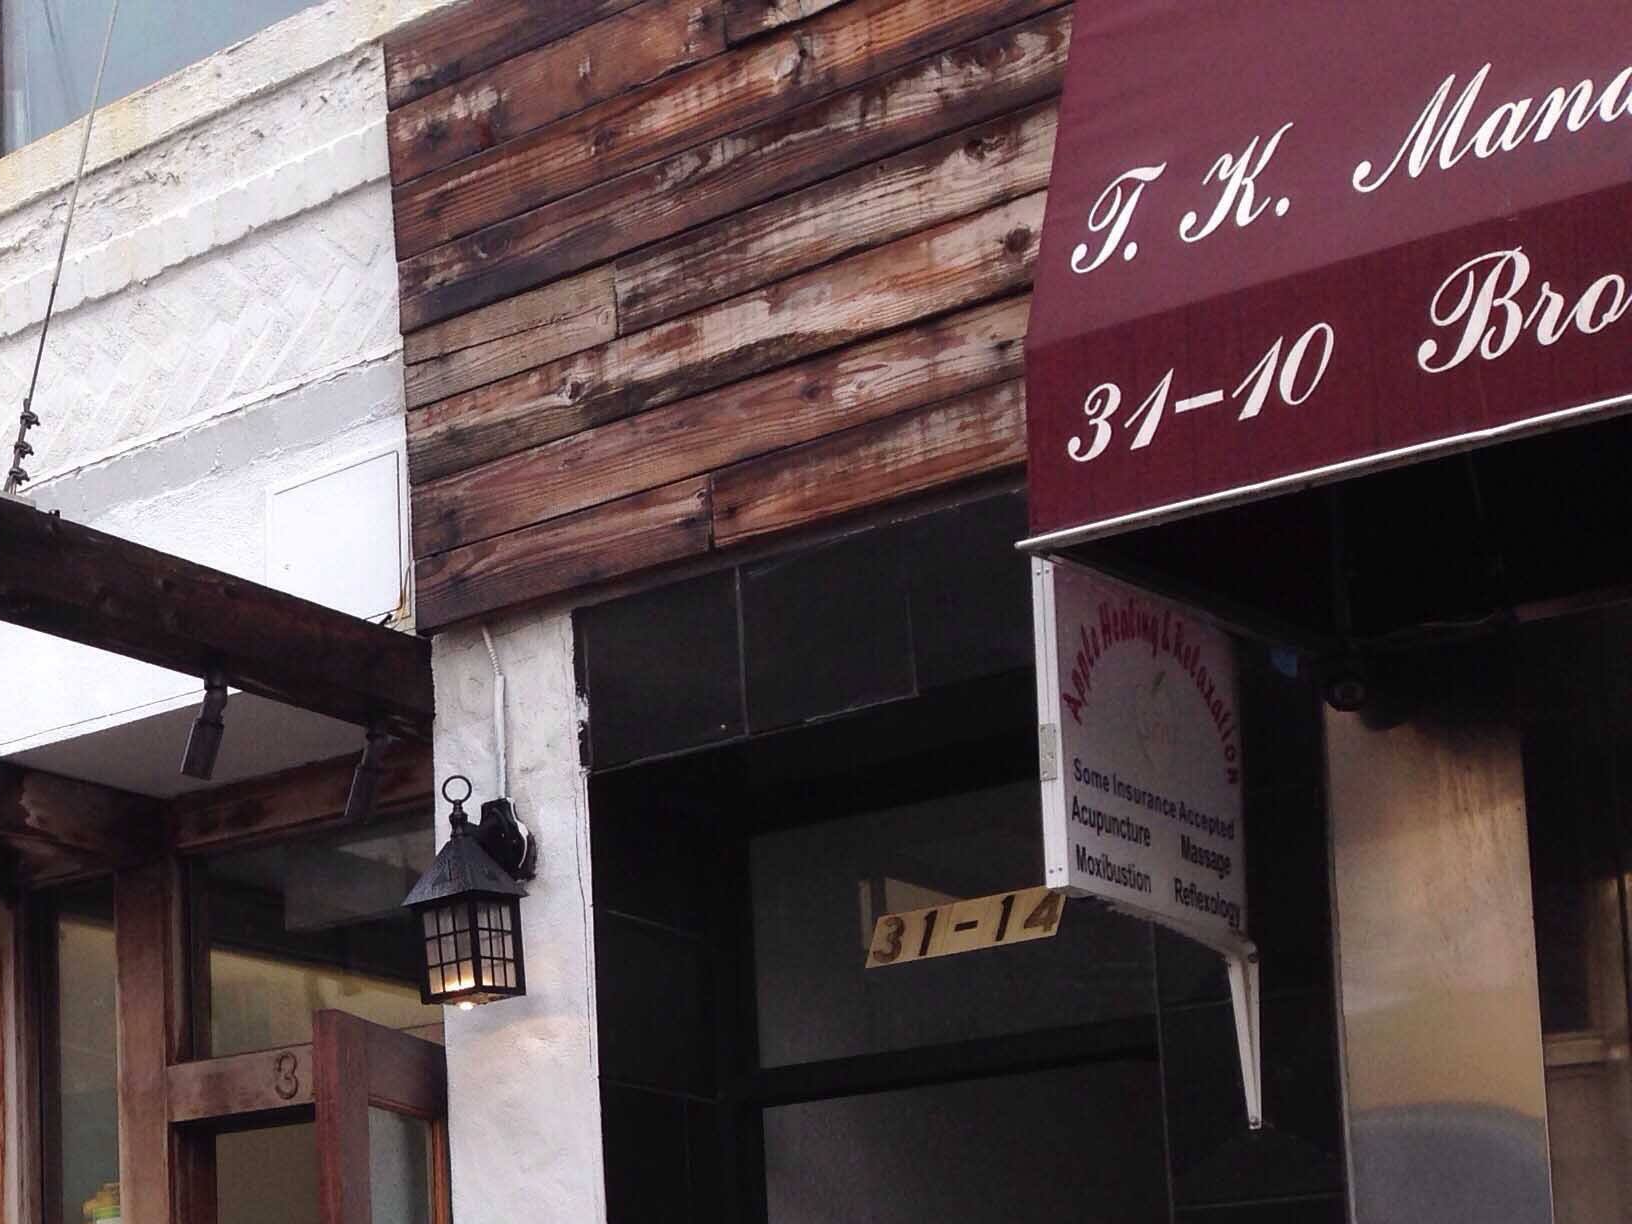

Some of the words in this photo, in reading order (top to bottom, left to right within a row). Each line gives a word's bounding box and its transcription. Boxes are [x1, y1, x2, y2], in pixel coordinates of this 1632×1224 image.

[1070, 161, 1168, 275] T.
[1179, 121, 1294, 244] K.
[1067, 322, 1335, 462] 31-10
[1071, 794, 1152, 848] Acupuncture
[1073, 757, 1110, 793] Some
[1113, 772, 1177, 819] Insurance
[1179, 800, 1235, 840] Accepted
[1075, 843, 1152, 894] Moxibustion
[1180, 834, 1232, 880] Massage
[872, 889, 1061, 964] 31-14
[1173, 876, 1241, 930] Reflexology
[273, 1050, 299, 1100] 3
